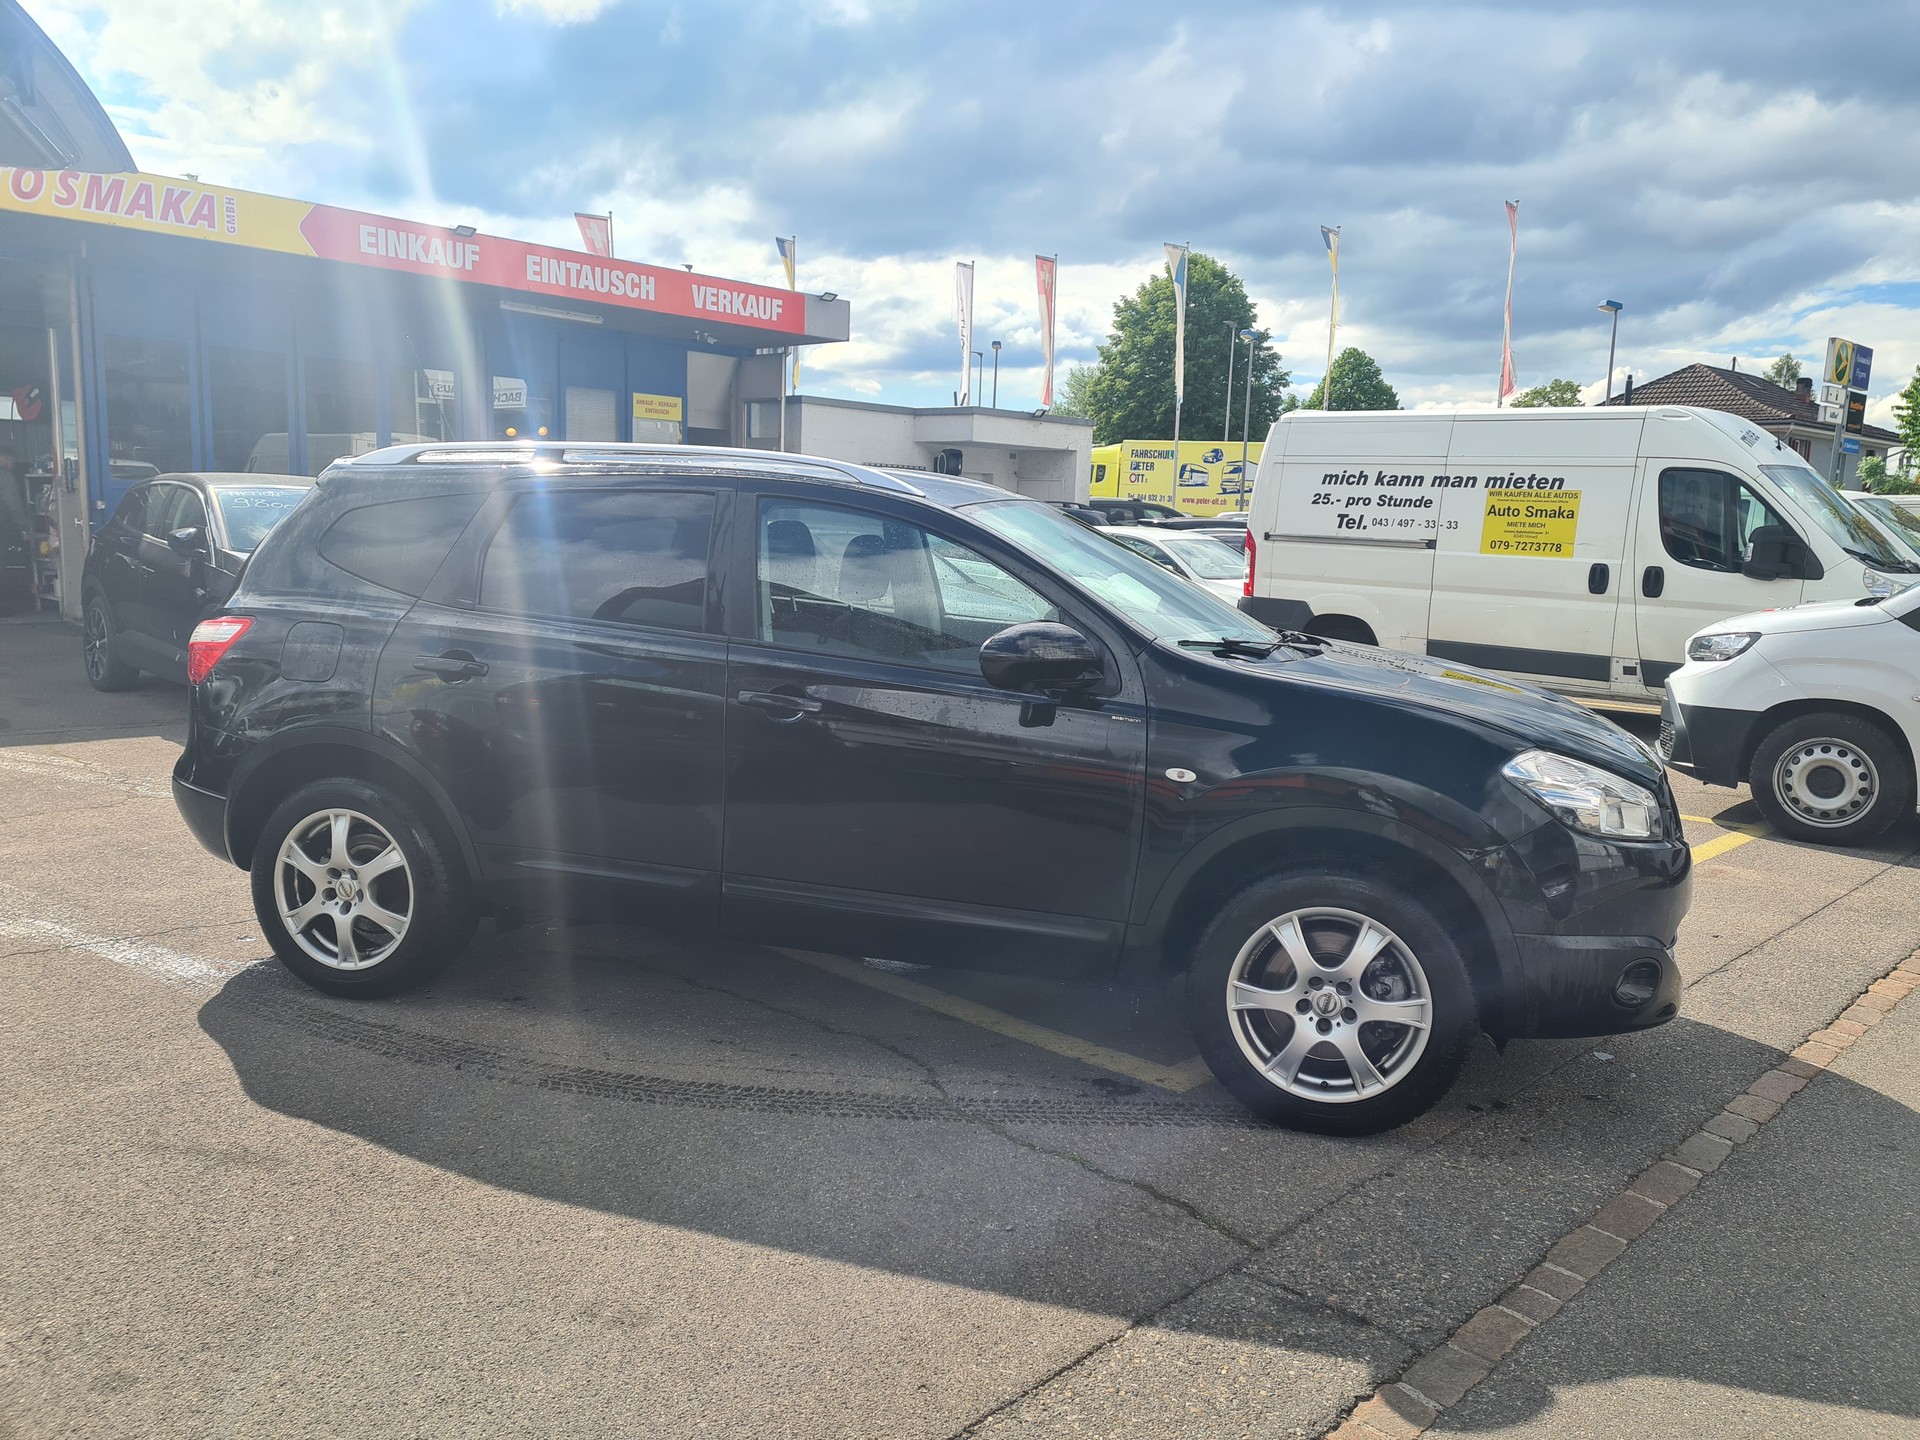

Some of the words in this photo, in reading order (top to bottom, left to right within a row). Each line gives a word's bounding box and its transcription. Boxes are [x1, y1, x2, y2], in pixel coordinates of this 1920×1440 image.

[2, 167, 45, 201] O
[54, 170, 217, 230] SMAKA
[225, 196, 236, 234] GMBH
[360, 224, 480, 271] EINKAUF
[526, 254, 655, 301] EINTAUSCH
[691, 284, 783, 321] VERKAUF
[1131, 449, 1176, 460] FAHRSCHUL
[1130, 461, 1155, 471] PETER
[1129, 473, 1145, 483] OTT
[1321, 470, 1369, 486] mich
[1374, 471, 1425, 487] kann
[1430, 475, 1478, 488] man
[1484, 472, 1565, 490] mieten
[1182, 496, 1228, 506] www.peter-ott.ch
[1311, 493, 1342, 506] 25.-
[1345, 496, 1372, 509] pro
[1376, 494, 1433, 509] Stunde
[1553, 492, 1579, 500] AUTOS
[1487, 504, 1520, 517] Auto
[1524, 505, 1575, 519] Smaka
[1337, 513, 1368, 530] Tel.
[1371, 517, 1389, 527] 043
[1397, 518, 1415, 528] 497
[1424, 519, 1437, 529] 33
[1446, 520, 1459, 530] 33
[1490, 540, 1562, 553] 079-7273778
